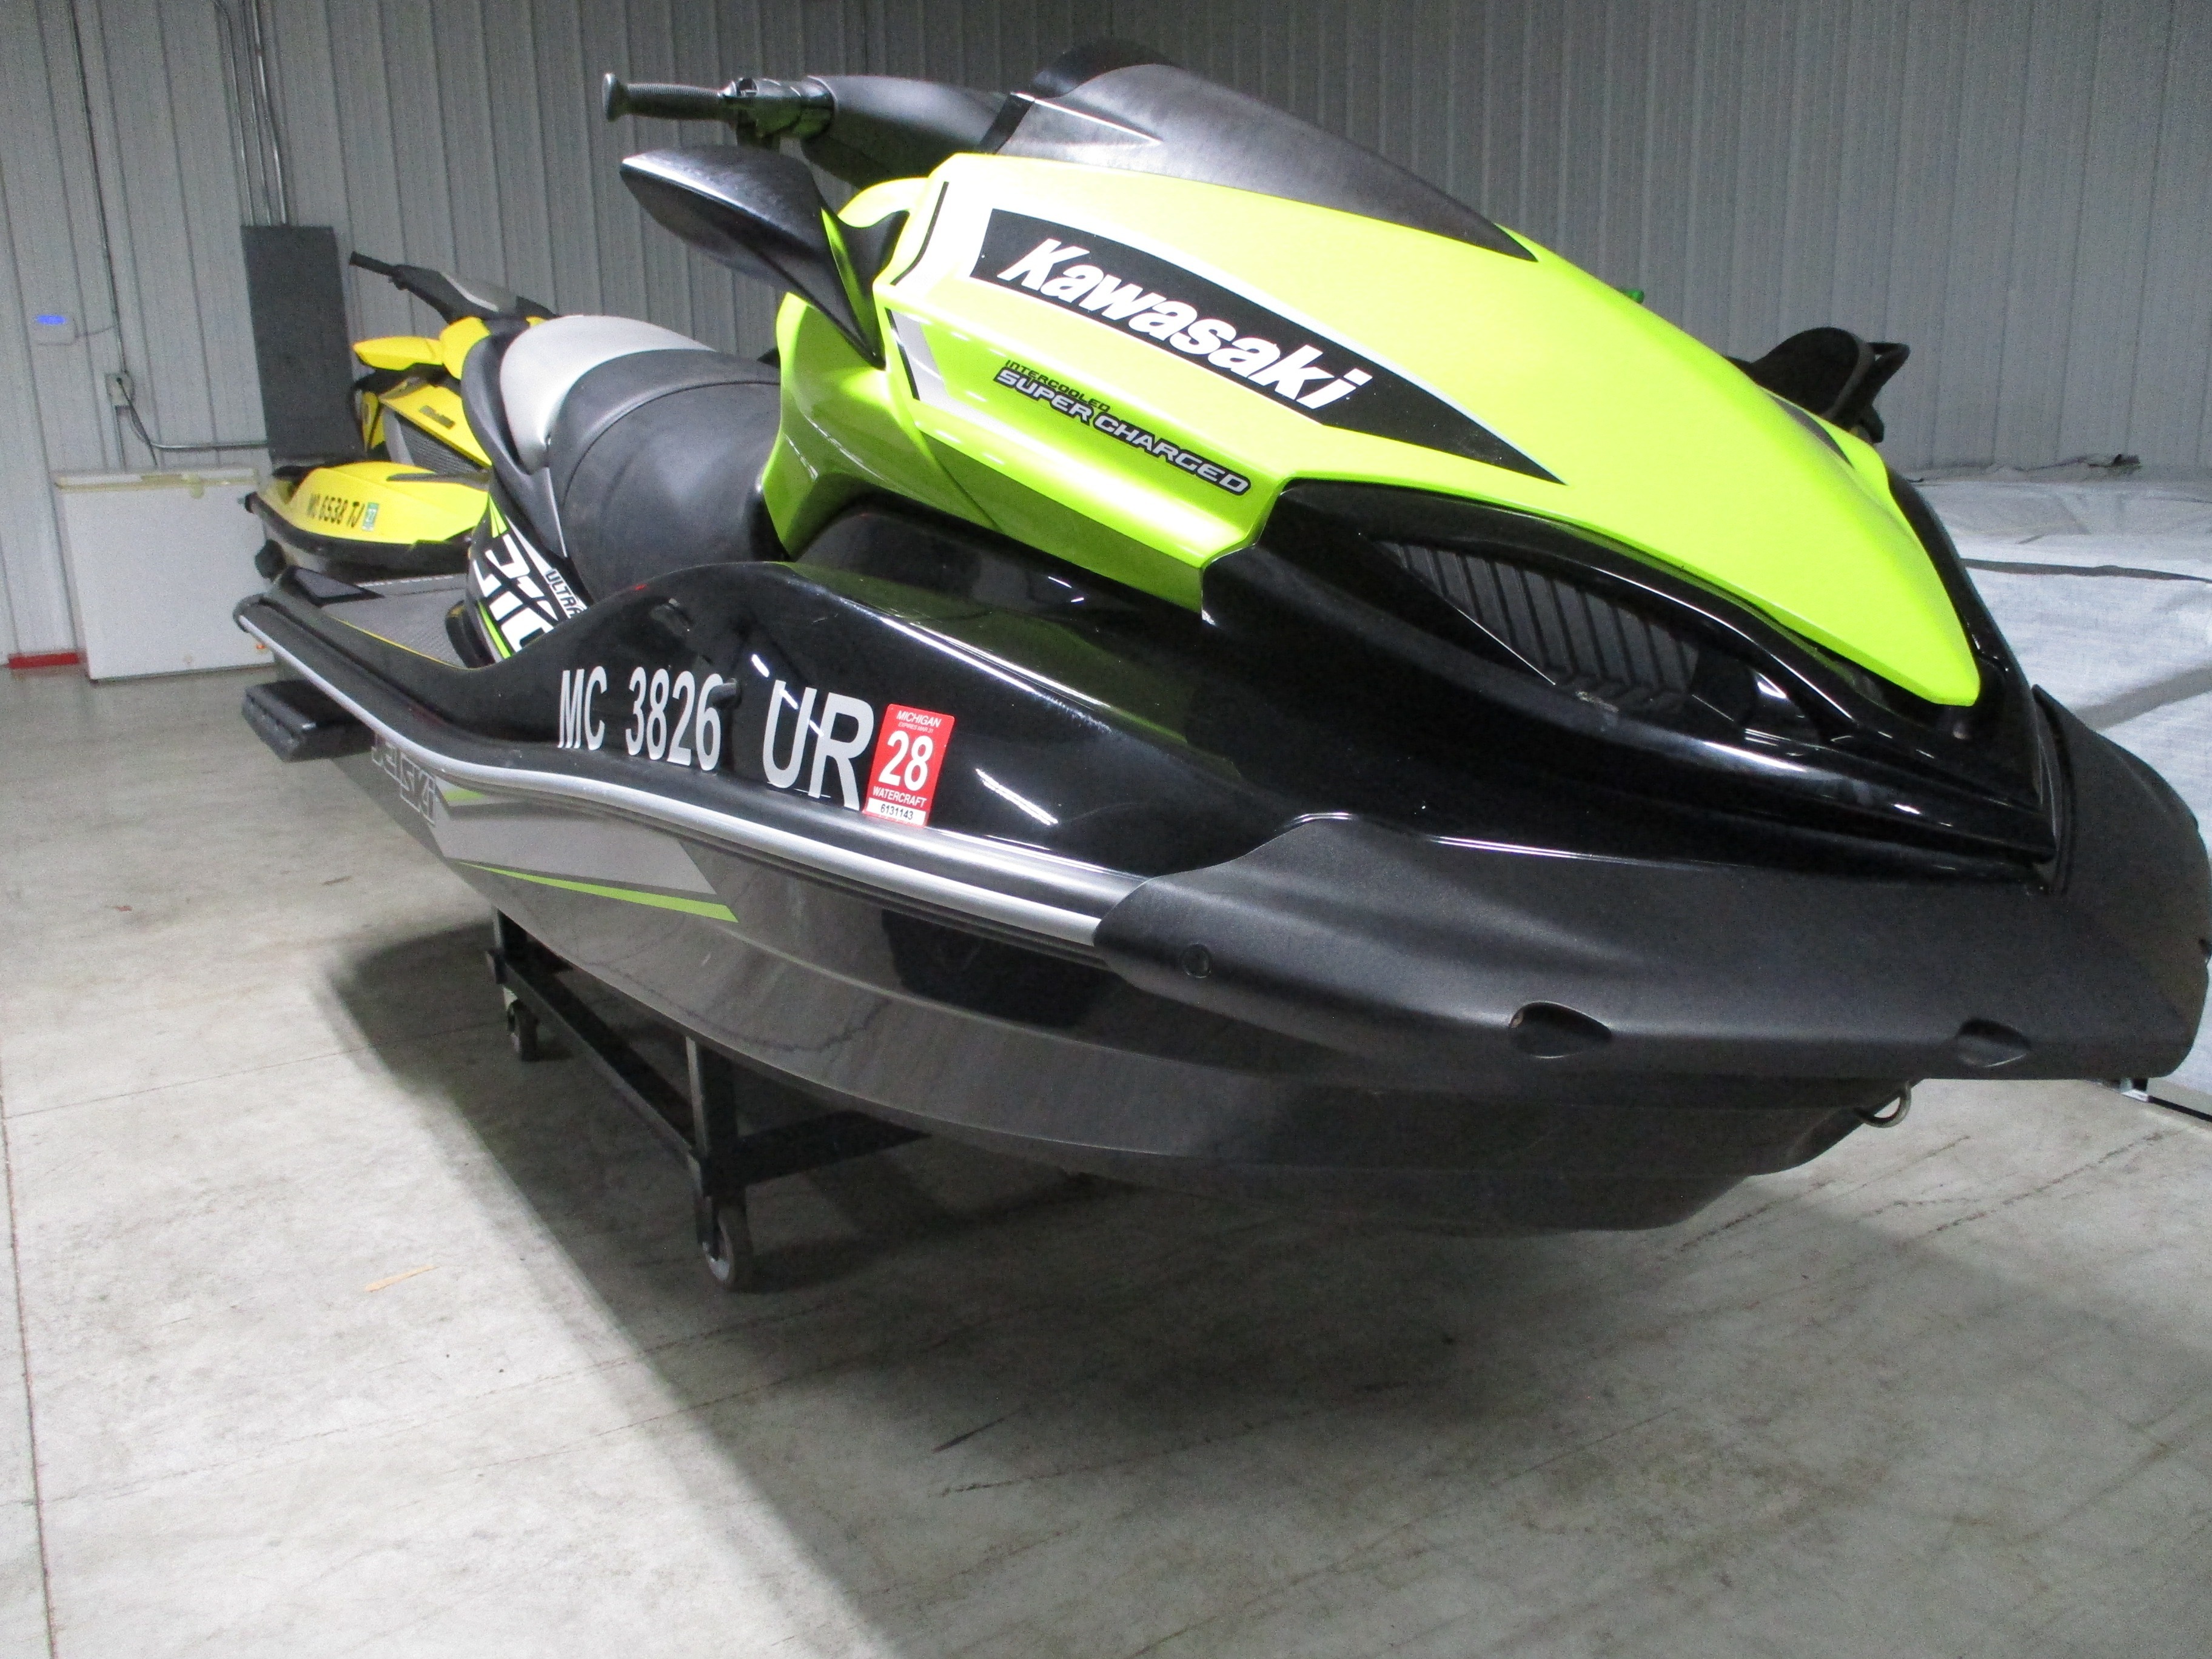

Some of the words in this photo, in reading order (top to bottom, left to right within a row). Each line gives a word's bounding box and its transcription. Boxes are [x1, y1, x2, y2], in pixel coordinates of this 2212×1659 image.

[997, 238, 1373, 410] Kawasaki
[1005, 360, 1112, 412] INTERCOOLED
[994, 367, 1093, 424] SUPER
[1094, 412, 1252, 495] CHARGED
[346, 501, 365, 528] TJ
[545, 569, 585, 616] ULTRA
[557, 666, 607, 751] MC
[625, 666, 724, 771] 3826
[762, 679, 874, 811] UR
[896, 710, 942, 728] MICHIGAN
[898, 722, 917, 731] EXPIRES
[878, 730, 933, 791] 28
[873, 786, 927, 808] WATERCRAFT
[880, 803, 913, 820] 6131143
